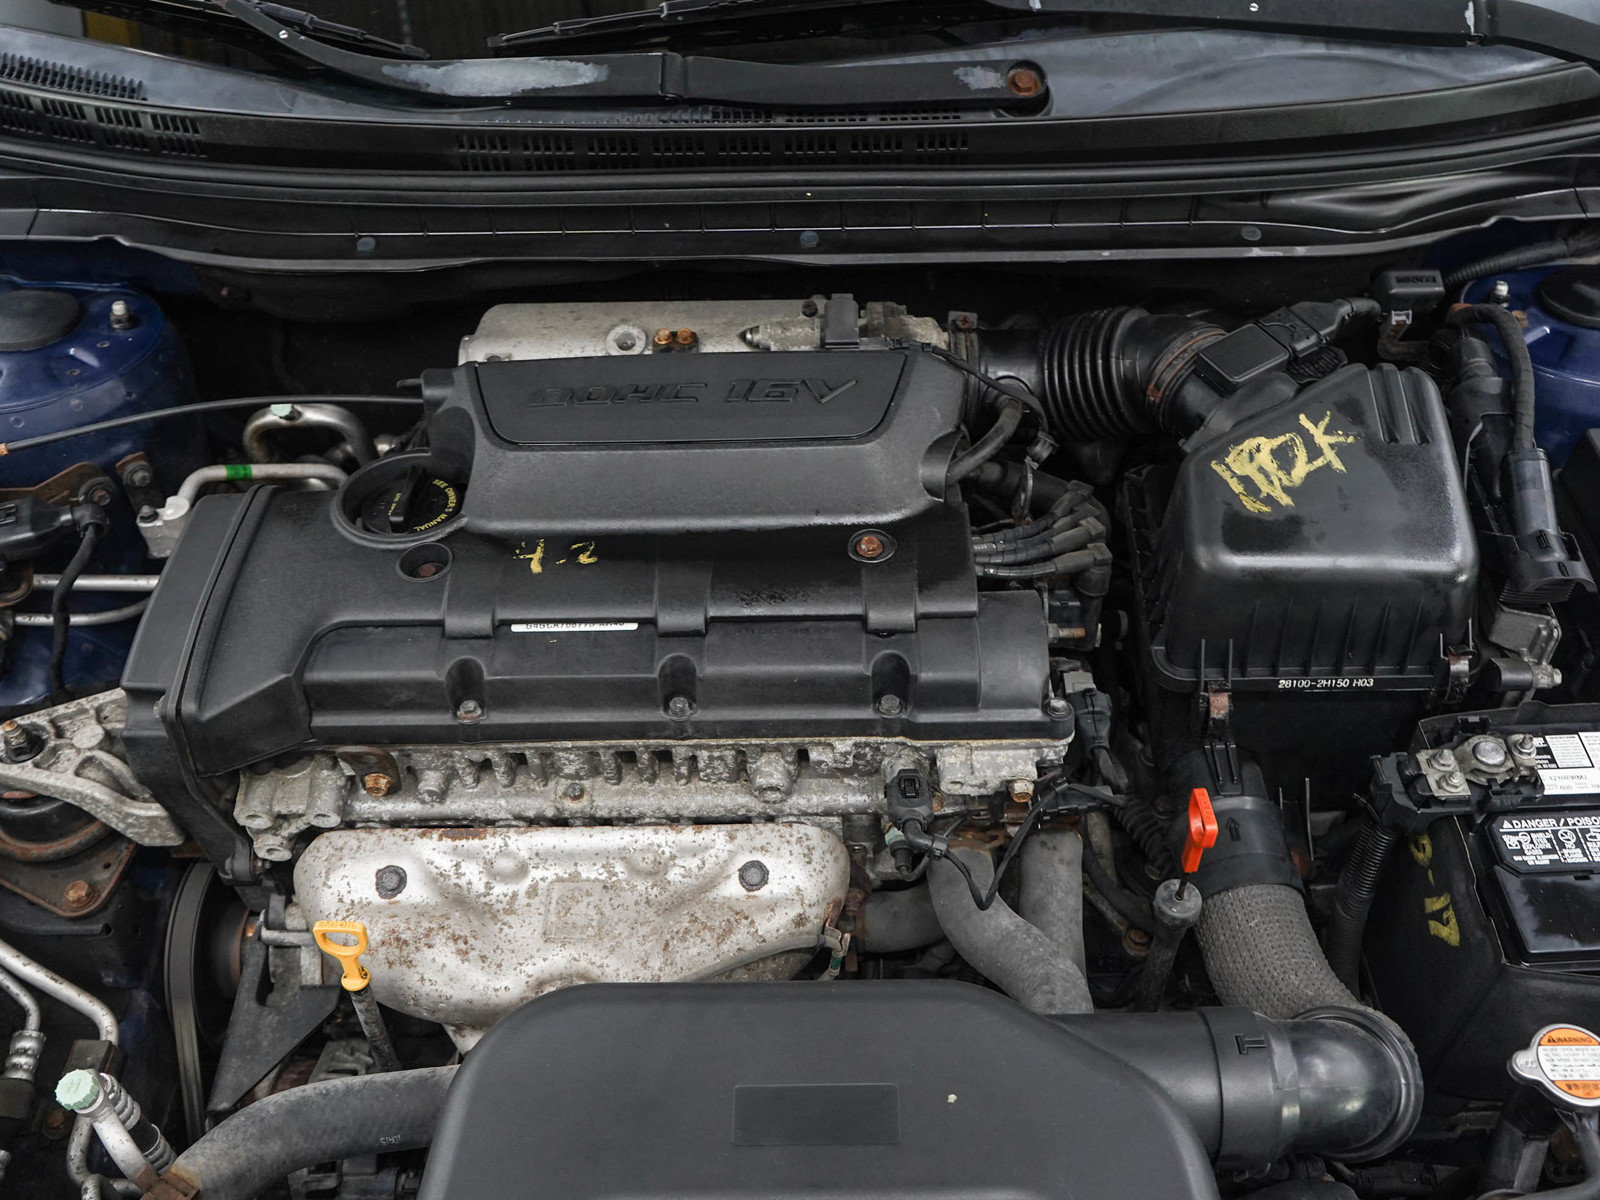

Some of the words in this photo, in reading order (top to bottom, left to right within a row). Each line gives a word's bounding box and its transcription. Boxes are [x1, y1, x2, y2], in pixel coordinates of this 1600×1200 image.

[527, 382, 708, 407] DOHC
[725, 378, 858, 404] 16V
[432, 479, 449, 489] SEE
[413, 513, 448, 532] MANUAL
[1278, 679, 1350, 688] 28100-2H150
[1352, 678, 1374, 687] H03
[1512, 819, 1558, 828] DANGER
[1566, 815, 1600, 826] POISO
